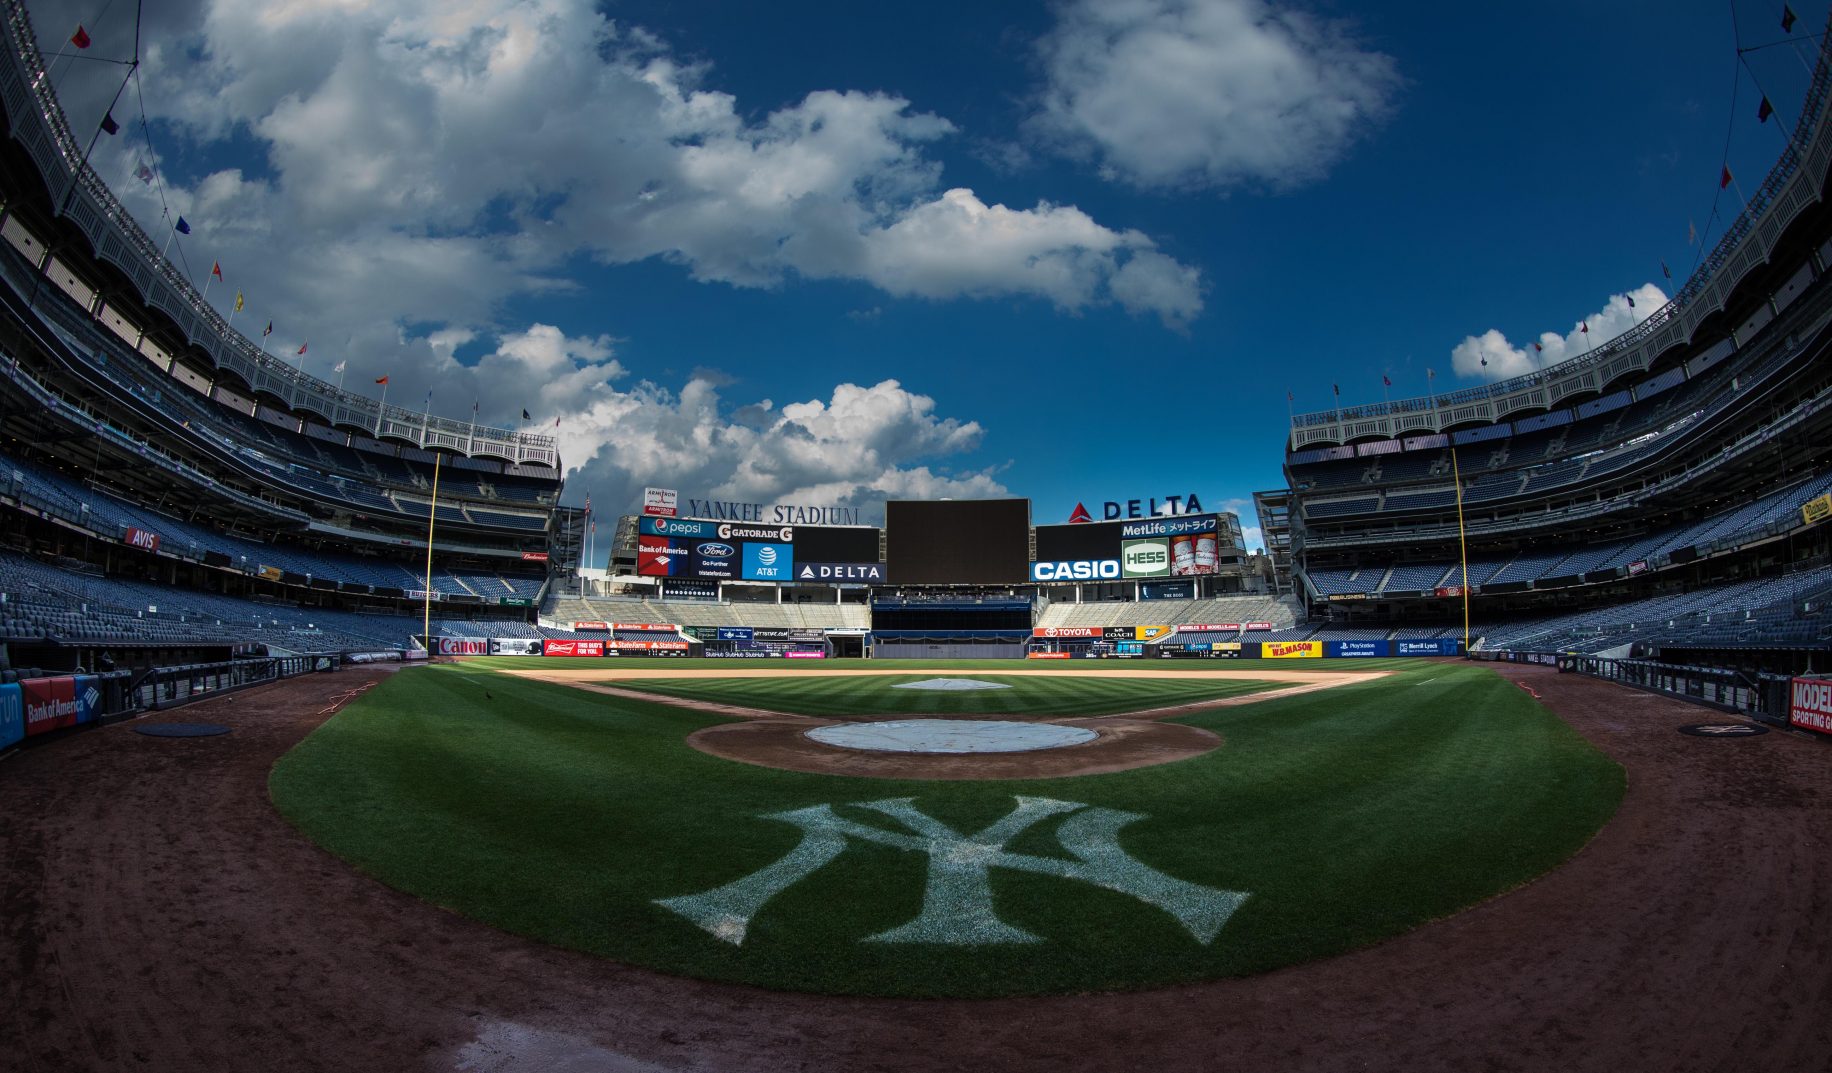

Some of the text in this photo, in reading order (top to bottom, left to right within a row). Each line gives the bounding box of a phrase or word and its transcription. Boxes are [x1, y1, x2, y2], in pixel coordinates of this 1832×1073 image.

[688, 499, 859, 525] YANKEE STADIUM
[1103, 494, 1203, 521] DELTA
[669, 523, 701, 534] pepsi
[1122, 523, 1167, 536] MetLife
[1169, 519, 1217, 532] メットライフ
[132, 530, 155, 548] AVIS
[718, 524, 793, 542] G GATORADE G
[639, 545, 655, 553] Bank
[662, 547, 688, 555] America
[703, 544, 727, 556] Ford
[1126, 551, 1165, 565] HESS
[756, 568, 778, 576] AT&T
[820, 566, 880, 578] DELTA
[1034, 560, 1119, 580] CASIO
[1059, 628, 1092, 636] TOYOTA
[439, 638, 487, 654] Canon
[27, 696, 84, 723] Bank of America
[1792, 709, 1825, 728] SPORTING
